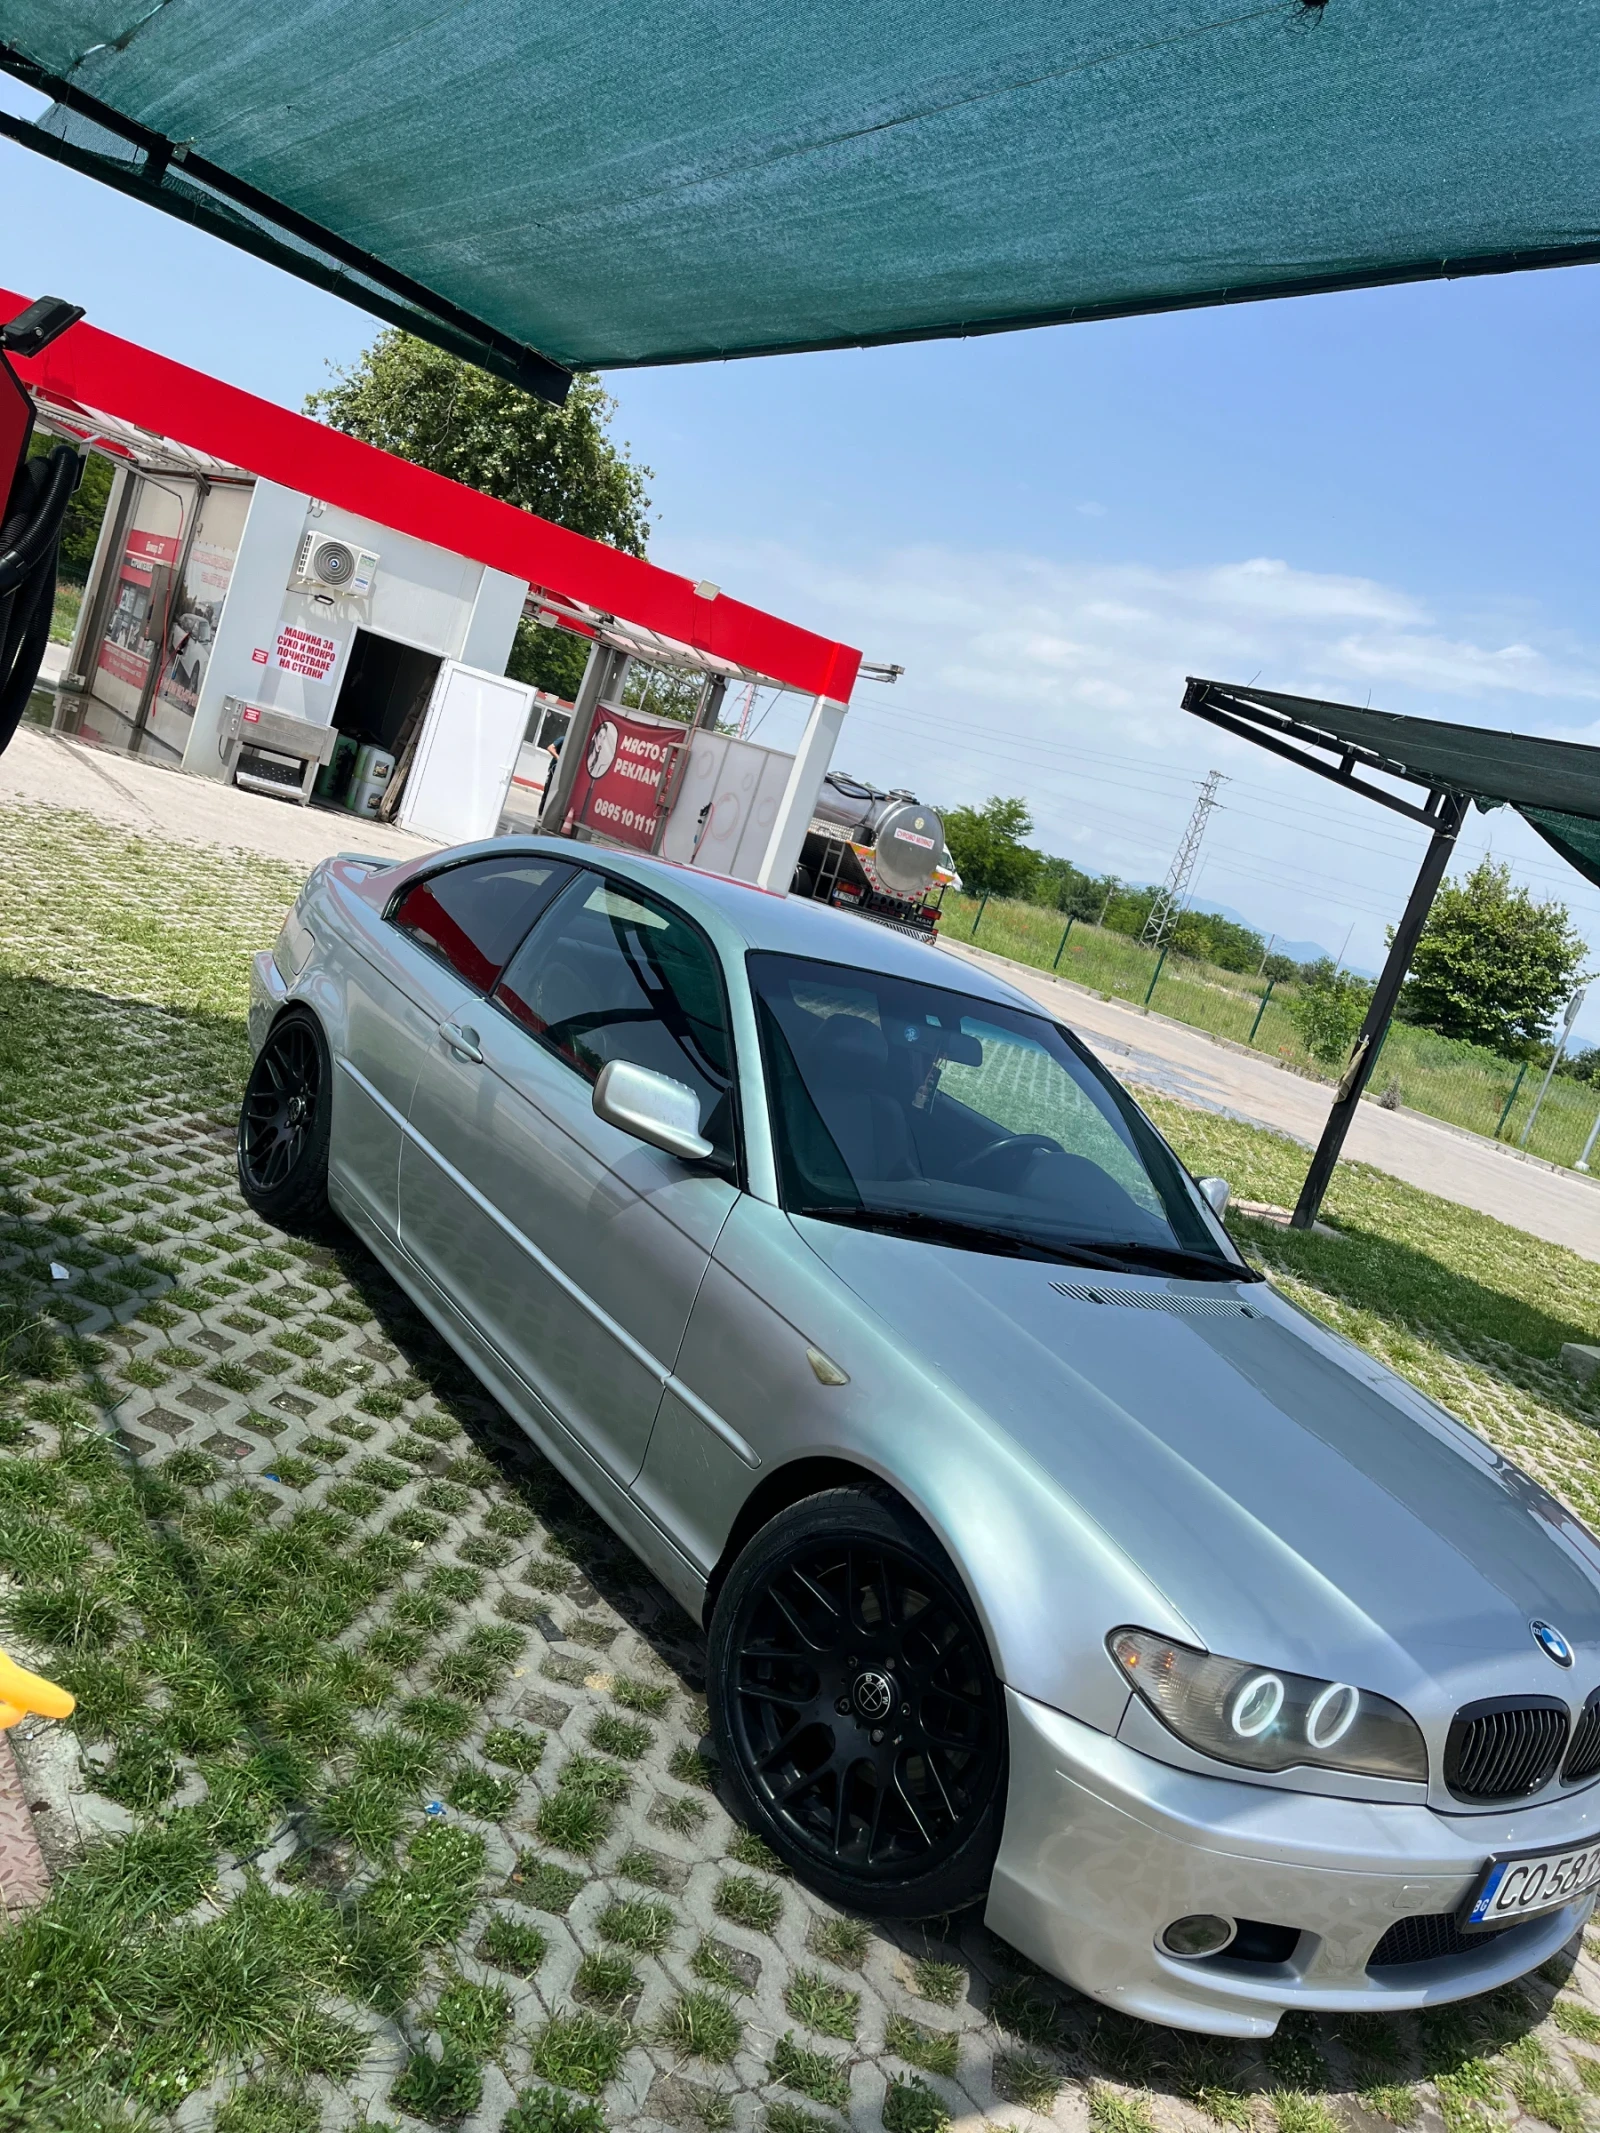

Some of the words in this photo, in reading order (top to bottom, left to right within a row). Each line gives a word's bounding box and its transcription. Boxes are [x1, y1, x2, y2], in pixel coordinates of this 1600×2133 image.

[277, 635, 298, 650] СУХО
[299, 642, 306, 652] И
[306, 645, 336, 662] МОКРО
[284, 626, 322, 647] МАШИНА
[323, 639, 334, 651] ЗА
[276, 646, 331, 672] ПОЧИСТВАНЕ
[279, 658, 290, 669] НА
[292, 662, 324, 680] СТЕЛКИ
[620, 735, 660, 760] МЯСТО
[659, 747, 668, 763] З
[613, 757, 661, 787] РЕКЛАМ
[594, 798, 621, 822] 0895
[621, 808, 634, 827] 10
[634, 814, 645, 832] 11
[645, 818, 657, 836] 11
[1496, 1864, 1548, 1910] CO
[1473, 1899, 1489, 1913] BG
